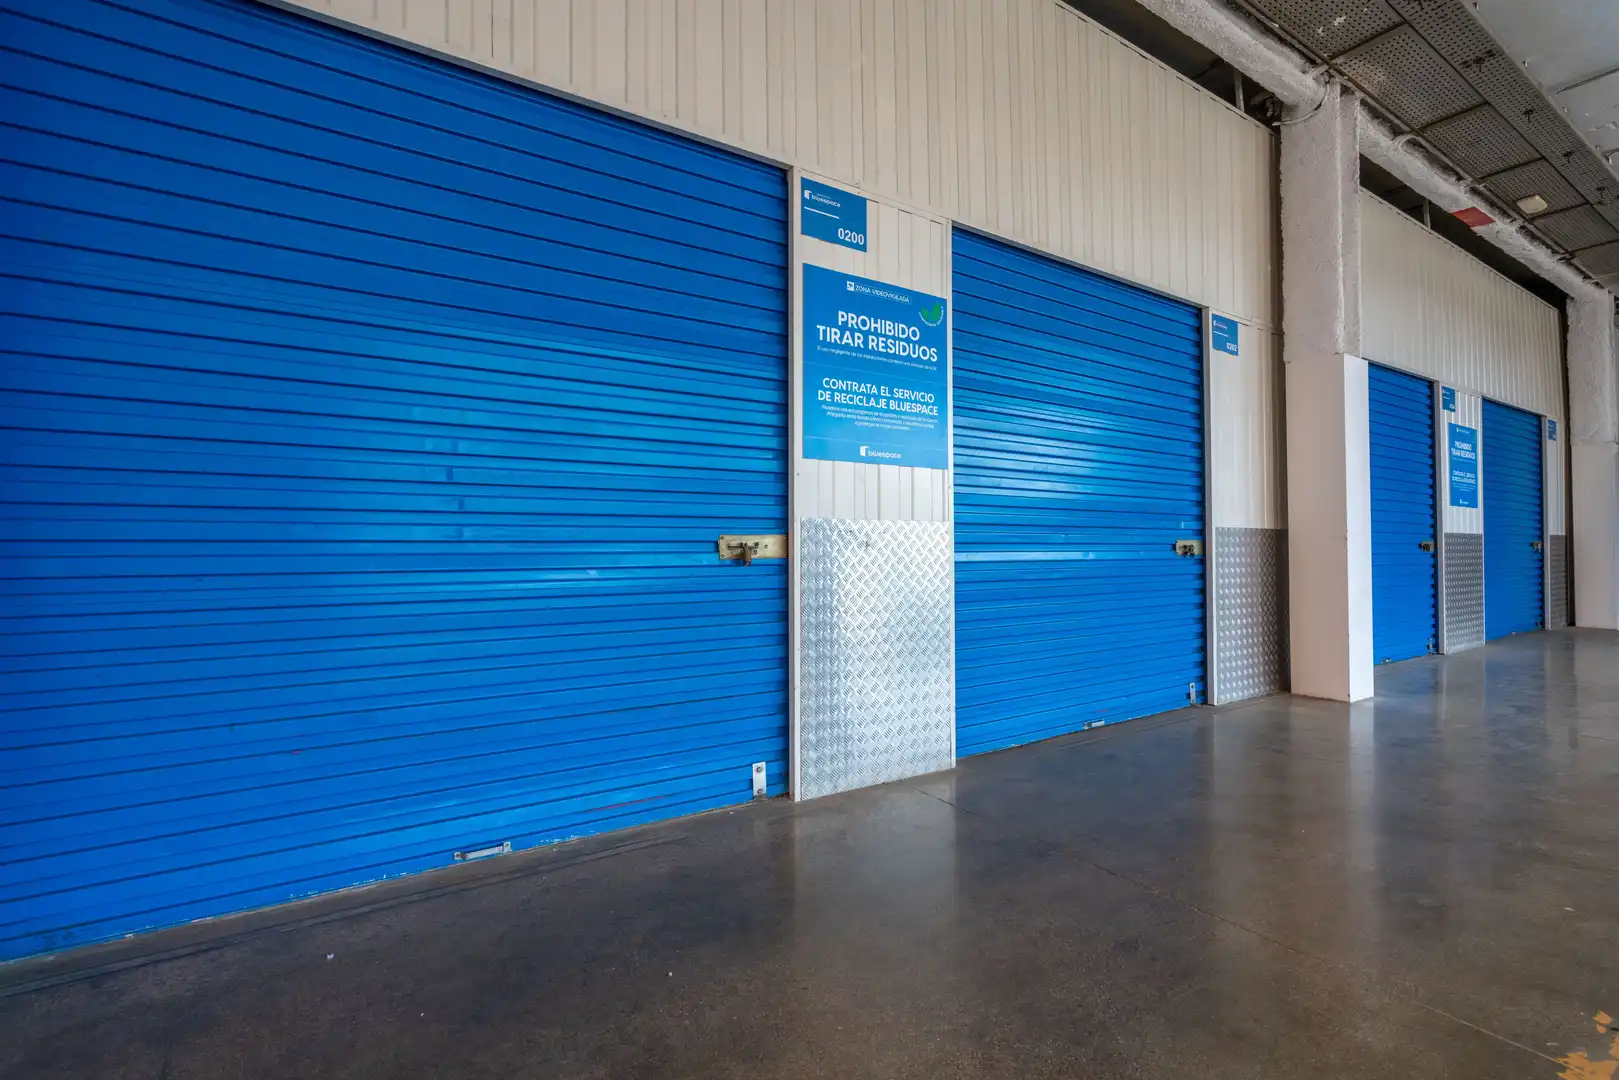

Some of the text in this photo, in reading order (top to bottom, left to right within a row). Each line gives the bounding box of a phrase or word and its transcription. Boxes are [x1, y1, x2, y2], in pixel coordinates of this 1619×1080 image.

[838, 227, 864, 245] 0200
[855, 284, 871, 294] ZONA
[838, 310, 920, 341] PROHIBIDO
[816, 324, 938, 362] TIRAR RESIDUOS
[817, 390, 939, 416] DE RECICLAJE BLUESPACE
[822, 377, 935, 403] CONTRATA EL SERVICIO
[868, 449, 902, 459] bluespace
